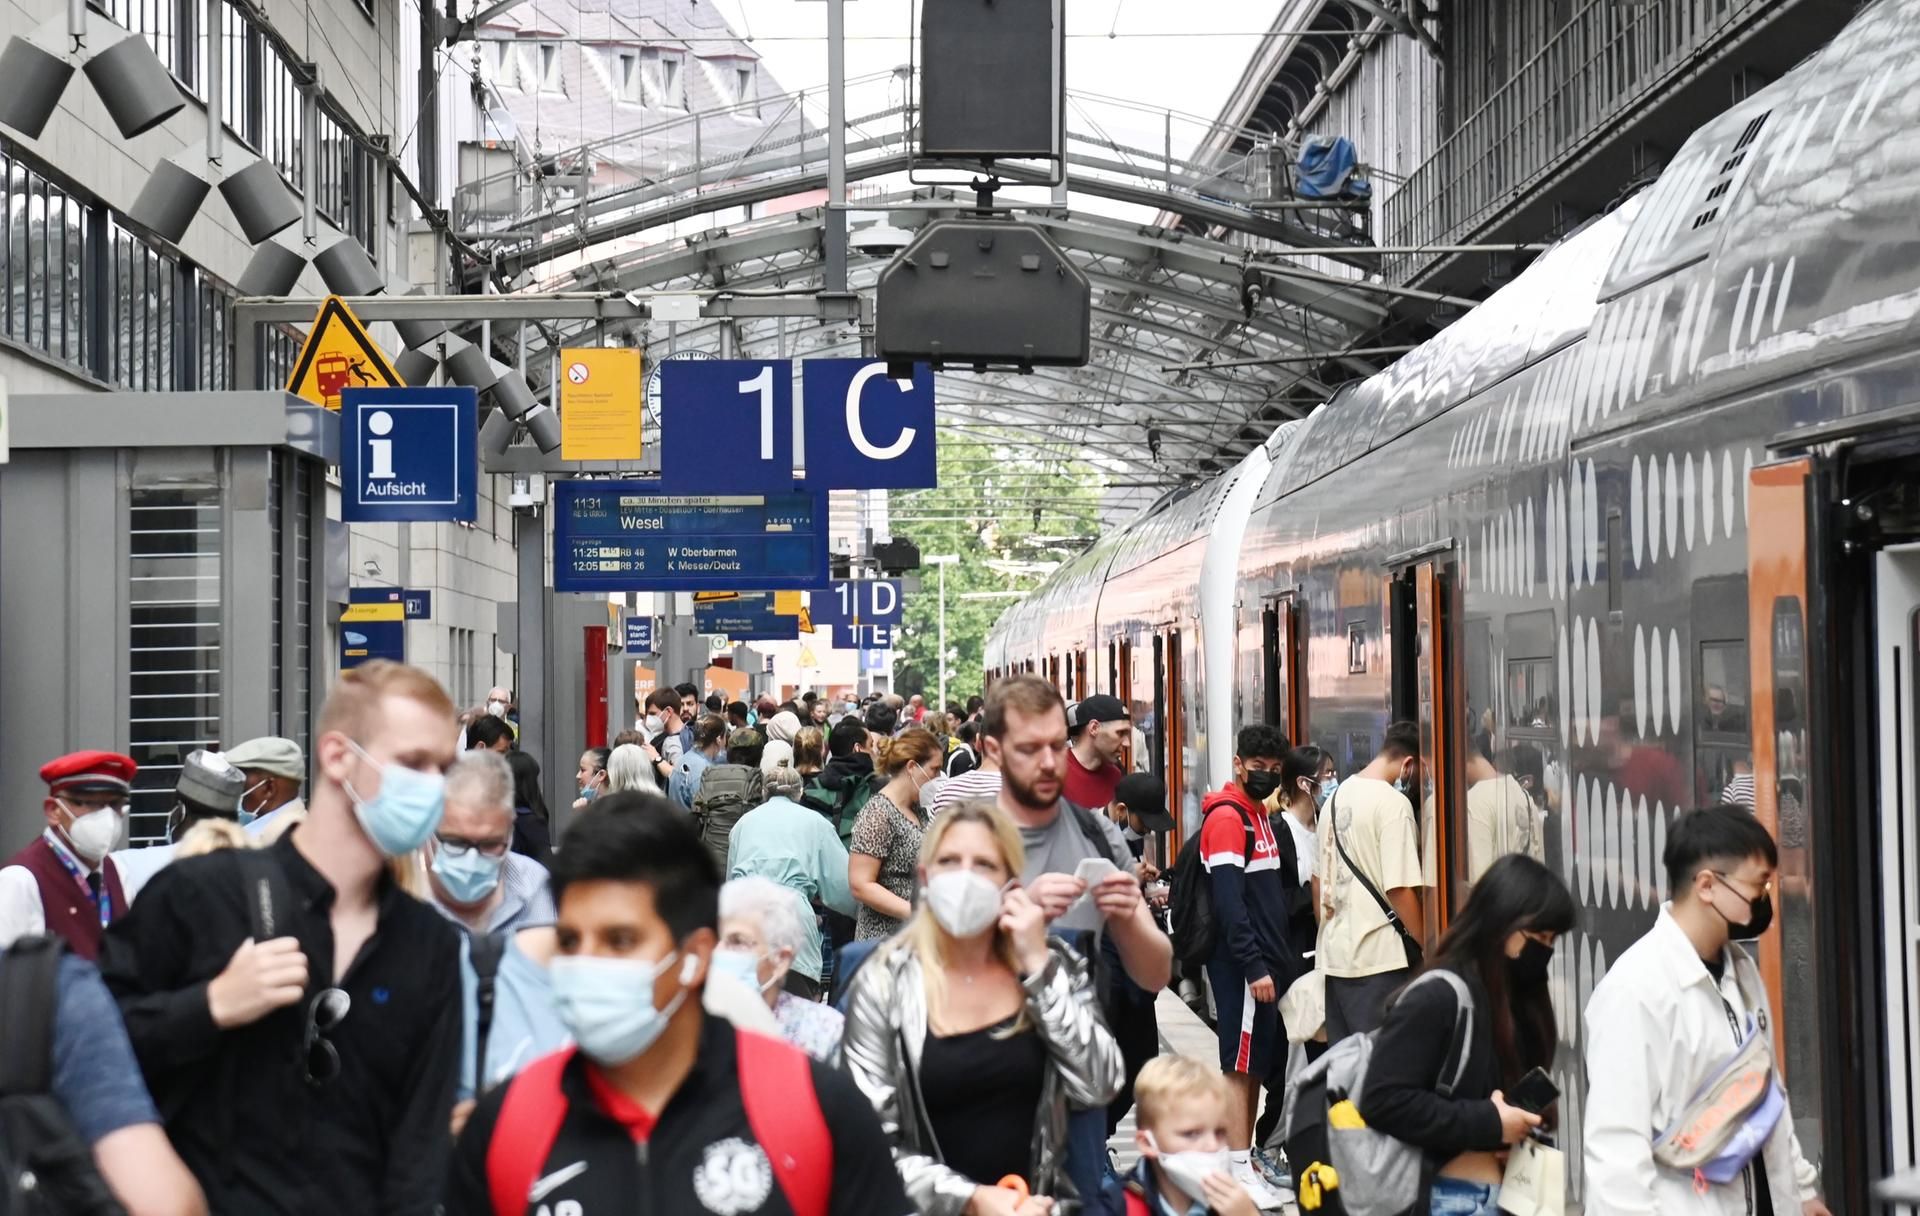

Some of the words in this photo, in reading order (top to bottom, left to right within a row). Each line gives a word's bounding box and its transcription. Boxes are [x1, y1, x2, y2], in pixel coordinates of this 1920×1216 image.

[739, 366, 773, 460] 1
[845, 362, 916, 460] C
[365, 481, 426, 496] Aufsicht
[573, 498, 601, 509] 11:31
[648, 496, 682, 505] Minuten
[620, 515, 665, 530] Wesel
[572, 547, 599, 557] 11:25
[620, 548, 632, 557] RB
[634, 548, 645, 557] 48
[668, 547, 678, 557] W
[681, 547, 738, 557] Oberbarmen
[572, 560, 599, 571] 12:05
[620, 561, 632, 571] RB
[634, 561, 645, 571] 26
[668, 561, 675, 571] K
[678, 560, 741, 571] Messe/Deutz
[835, 582, 848, 616] 1
[872, 582, 896, 616] D
[627, 624, 649, 632] Wagen-
[847, 625, 857, 644] 1
[873, 625, 888, 645] E
